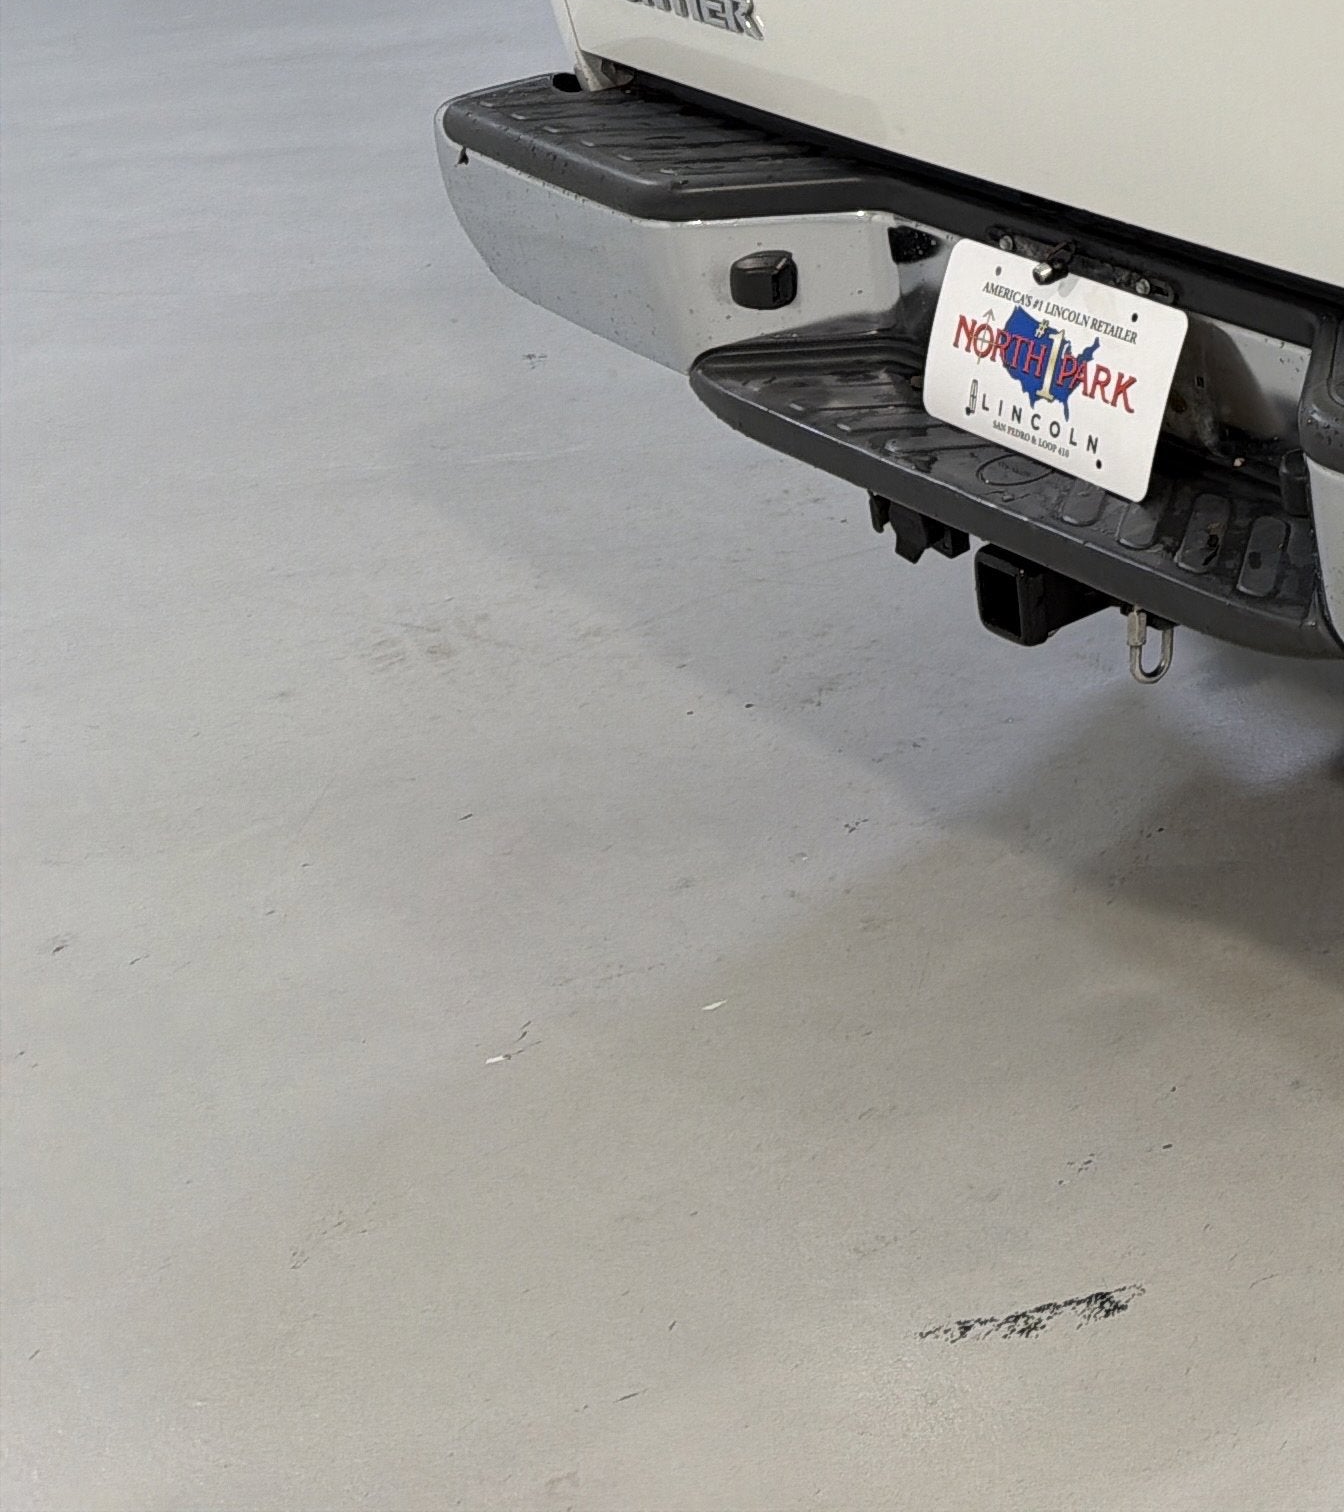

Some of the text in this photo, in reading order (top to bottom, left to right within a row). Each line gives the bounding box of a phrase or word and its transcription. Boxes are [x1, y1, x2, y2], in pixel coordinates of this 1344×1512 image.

[982, 281, 1138, 345] AMERICA'S #1 LINCOLN RETAILER
[952, 314, 1137, 414] NORTH PARK
[982, 393, 1099, 454] LINCOLN
[992, 419, 1006, 433] SAN
[1007, 425, 1031, 442] PEDRO
[1038, 438, 1057, 453] LOOP
